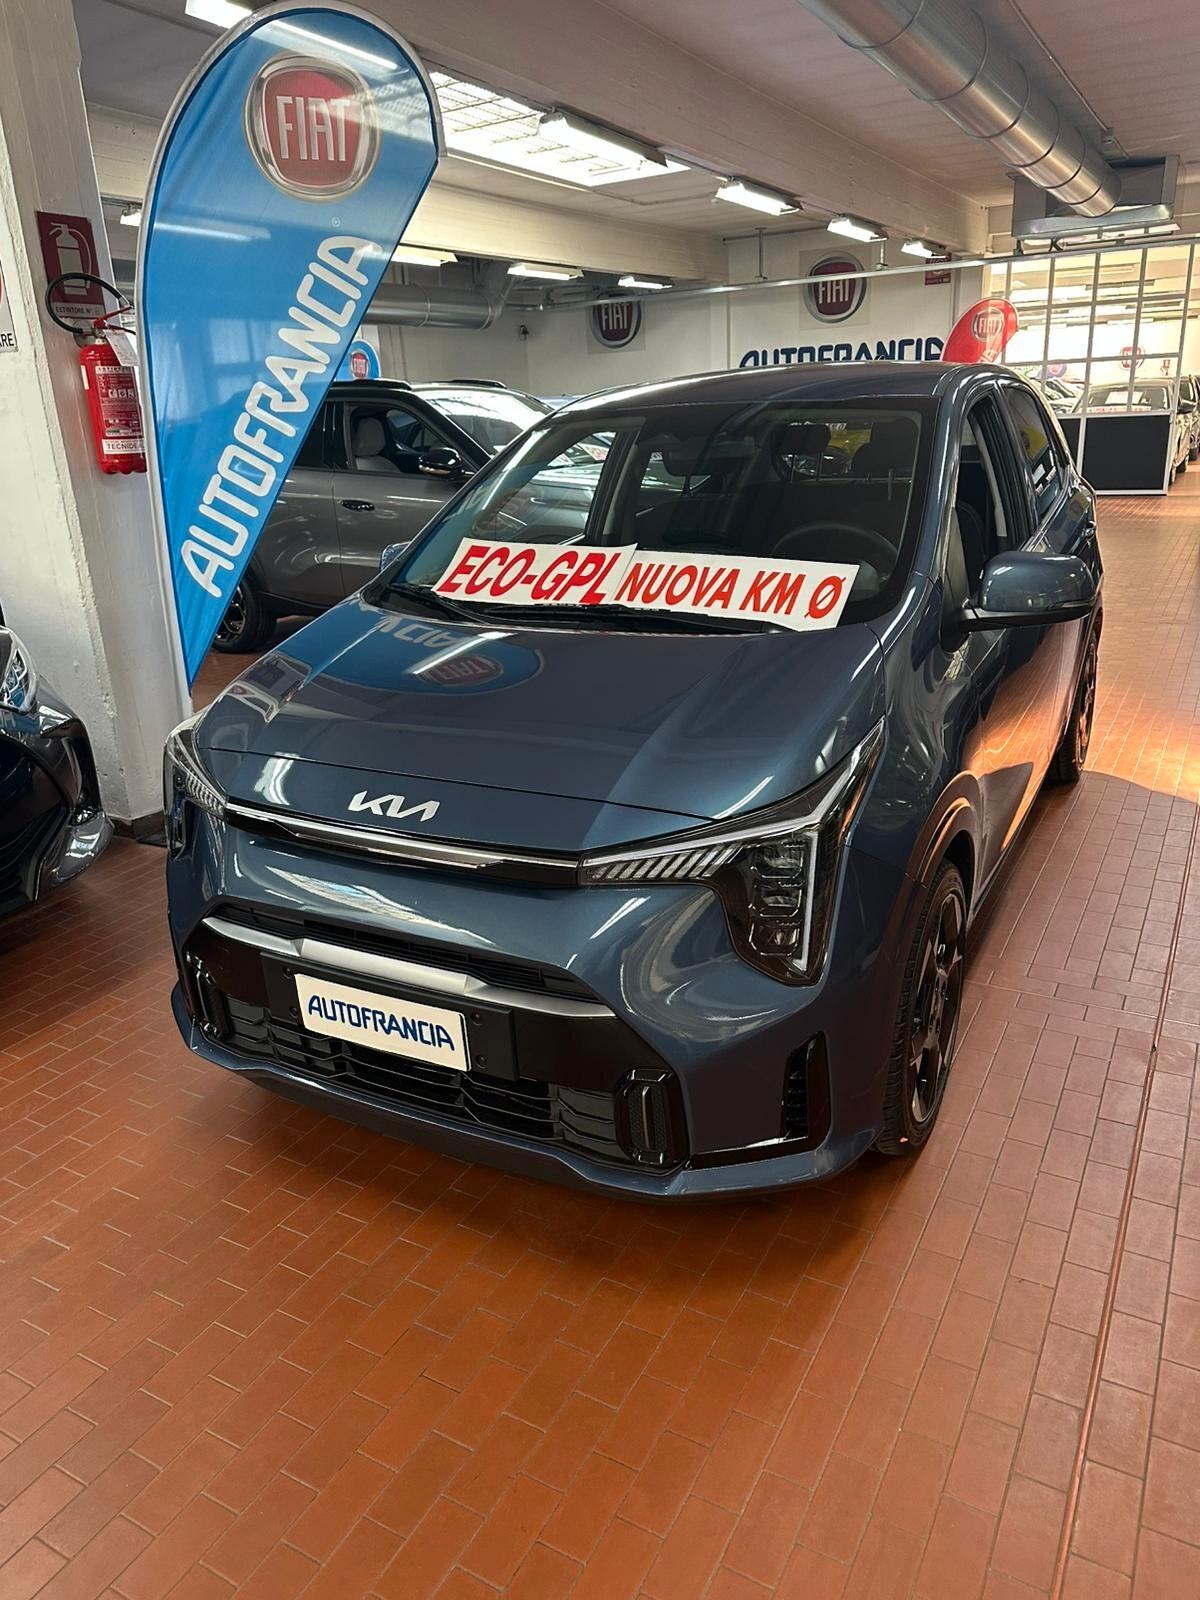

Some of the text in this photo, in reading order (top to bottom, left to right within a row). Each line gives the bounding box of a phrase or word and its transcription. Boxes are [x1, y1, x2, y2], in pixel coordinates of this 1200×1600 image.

[276, 95, 351, 162] FIAT
[818, 278, 850, 305] FIAT
[601, 302, 629, 331] FIAT
[979, 317, 998, 333] FIAT
[181, 235, 383, 598] AUTOFRANCIA
[442, 545, 622, 604] ECO-GPL
[618, 563, 735, 609] NUOVA
[740, 571, 807, 616] KM
[348, 791, 441, 822] KIA
[308, 994, 455, 1051] AUTOFRANCIA
